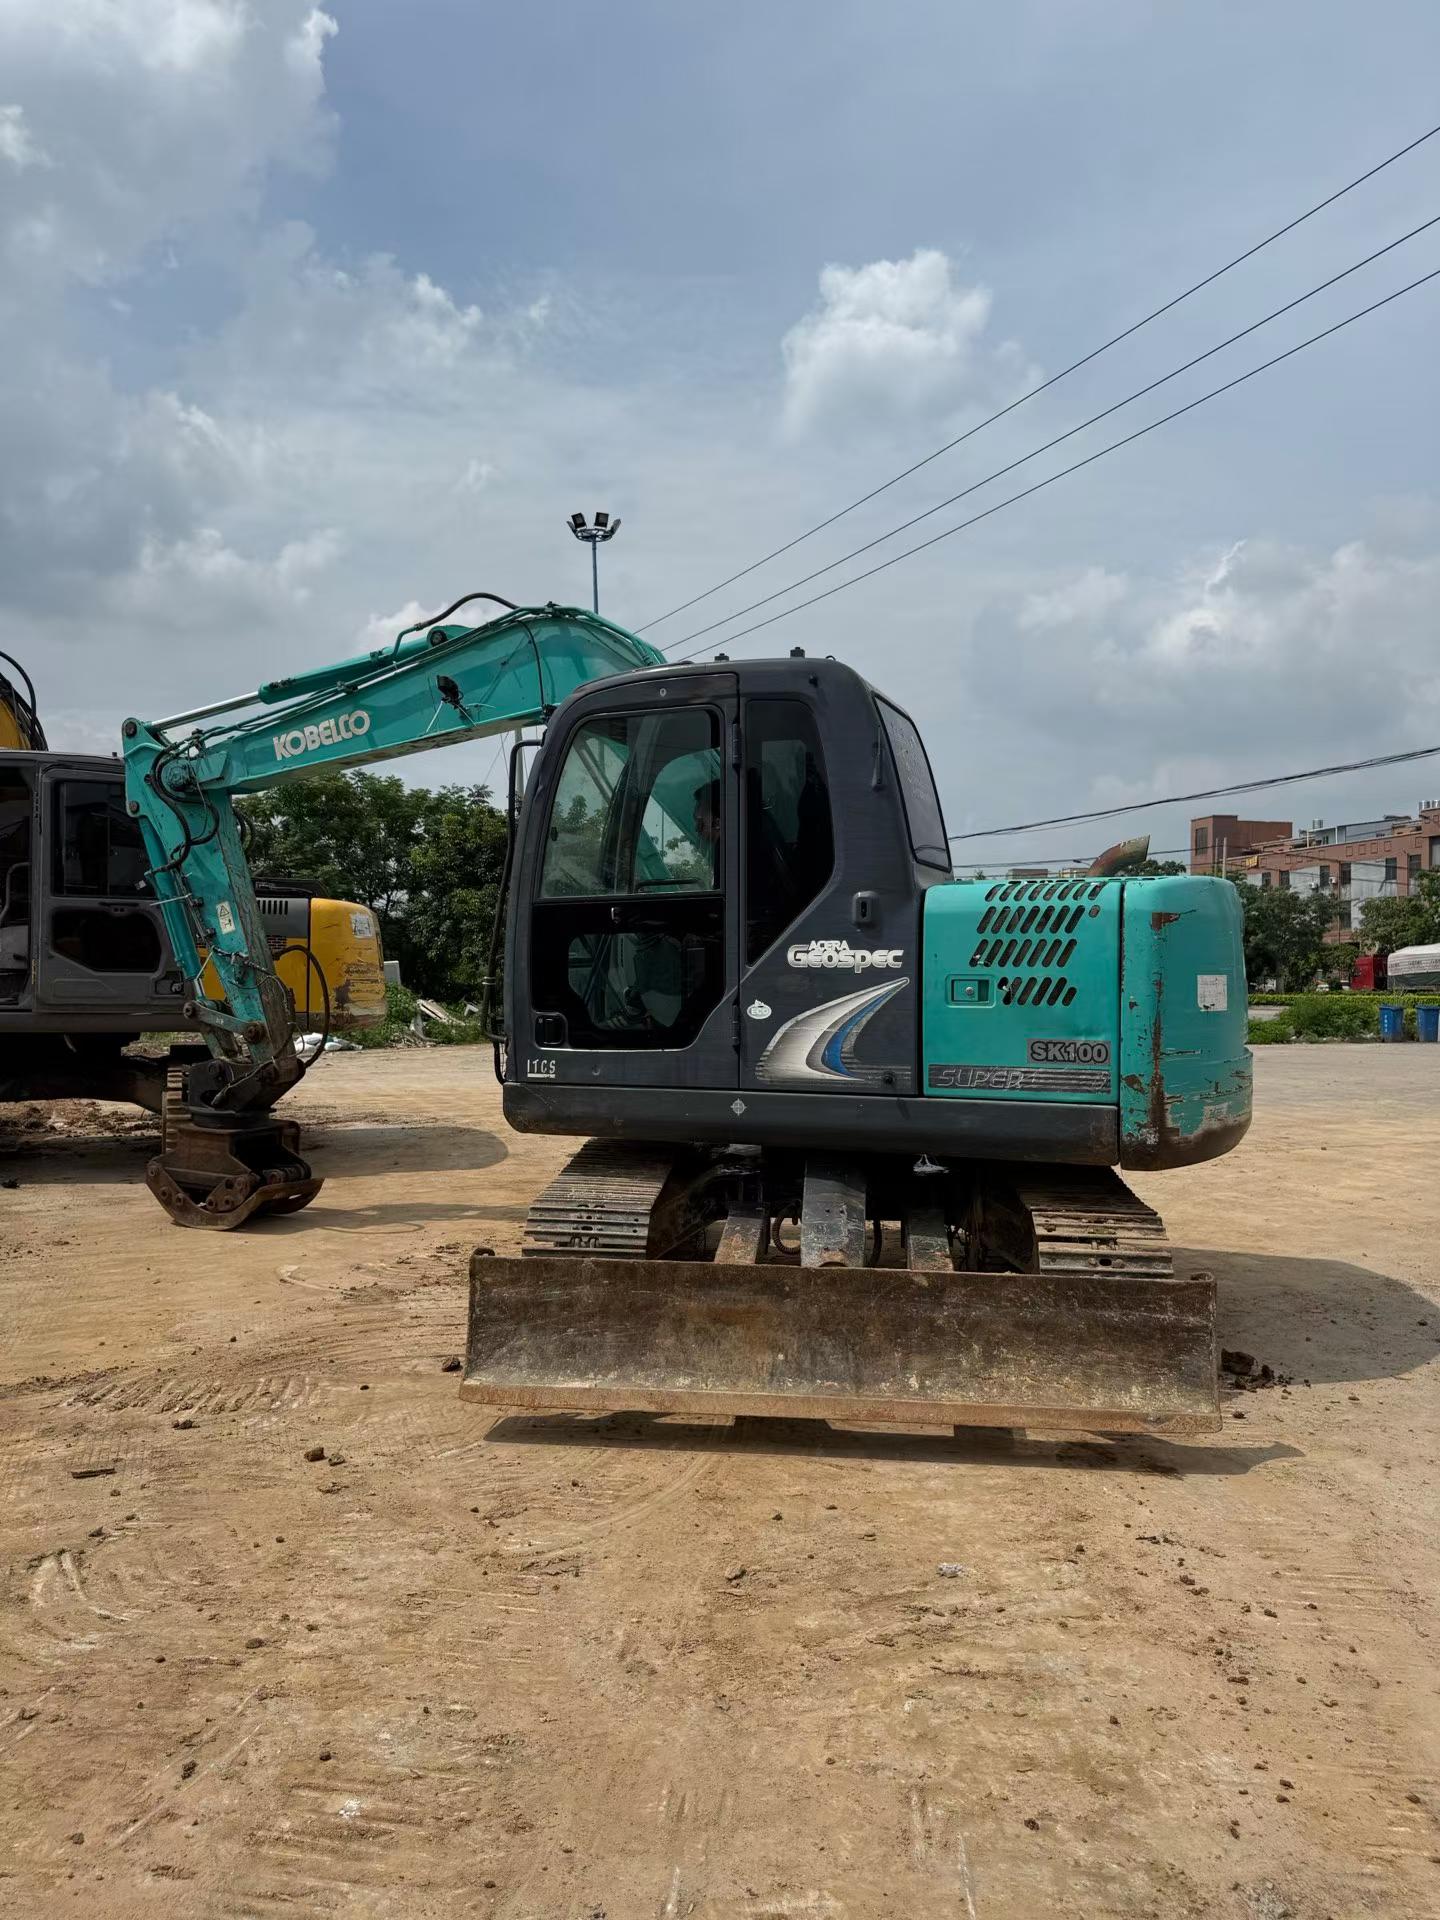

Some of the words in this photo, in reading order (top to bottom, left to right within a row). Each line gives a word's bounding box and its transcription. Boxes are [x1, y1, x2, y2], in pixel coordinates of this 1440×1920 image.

[273, 710, 371, 761] KOBELCO
[808, 940, 850, 952] ACERA
[751, 1007, 769, 1016] ECO
[1031, 1041, 1108, 1064] SK100
[527, 1059, 556, 1073] ITCS
[936, 1068, 1024, 1089] SUPER
